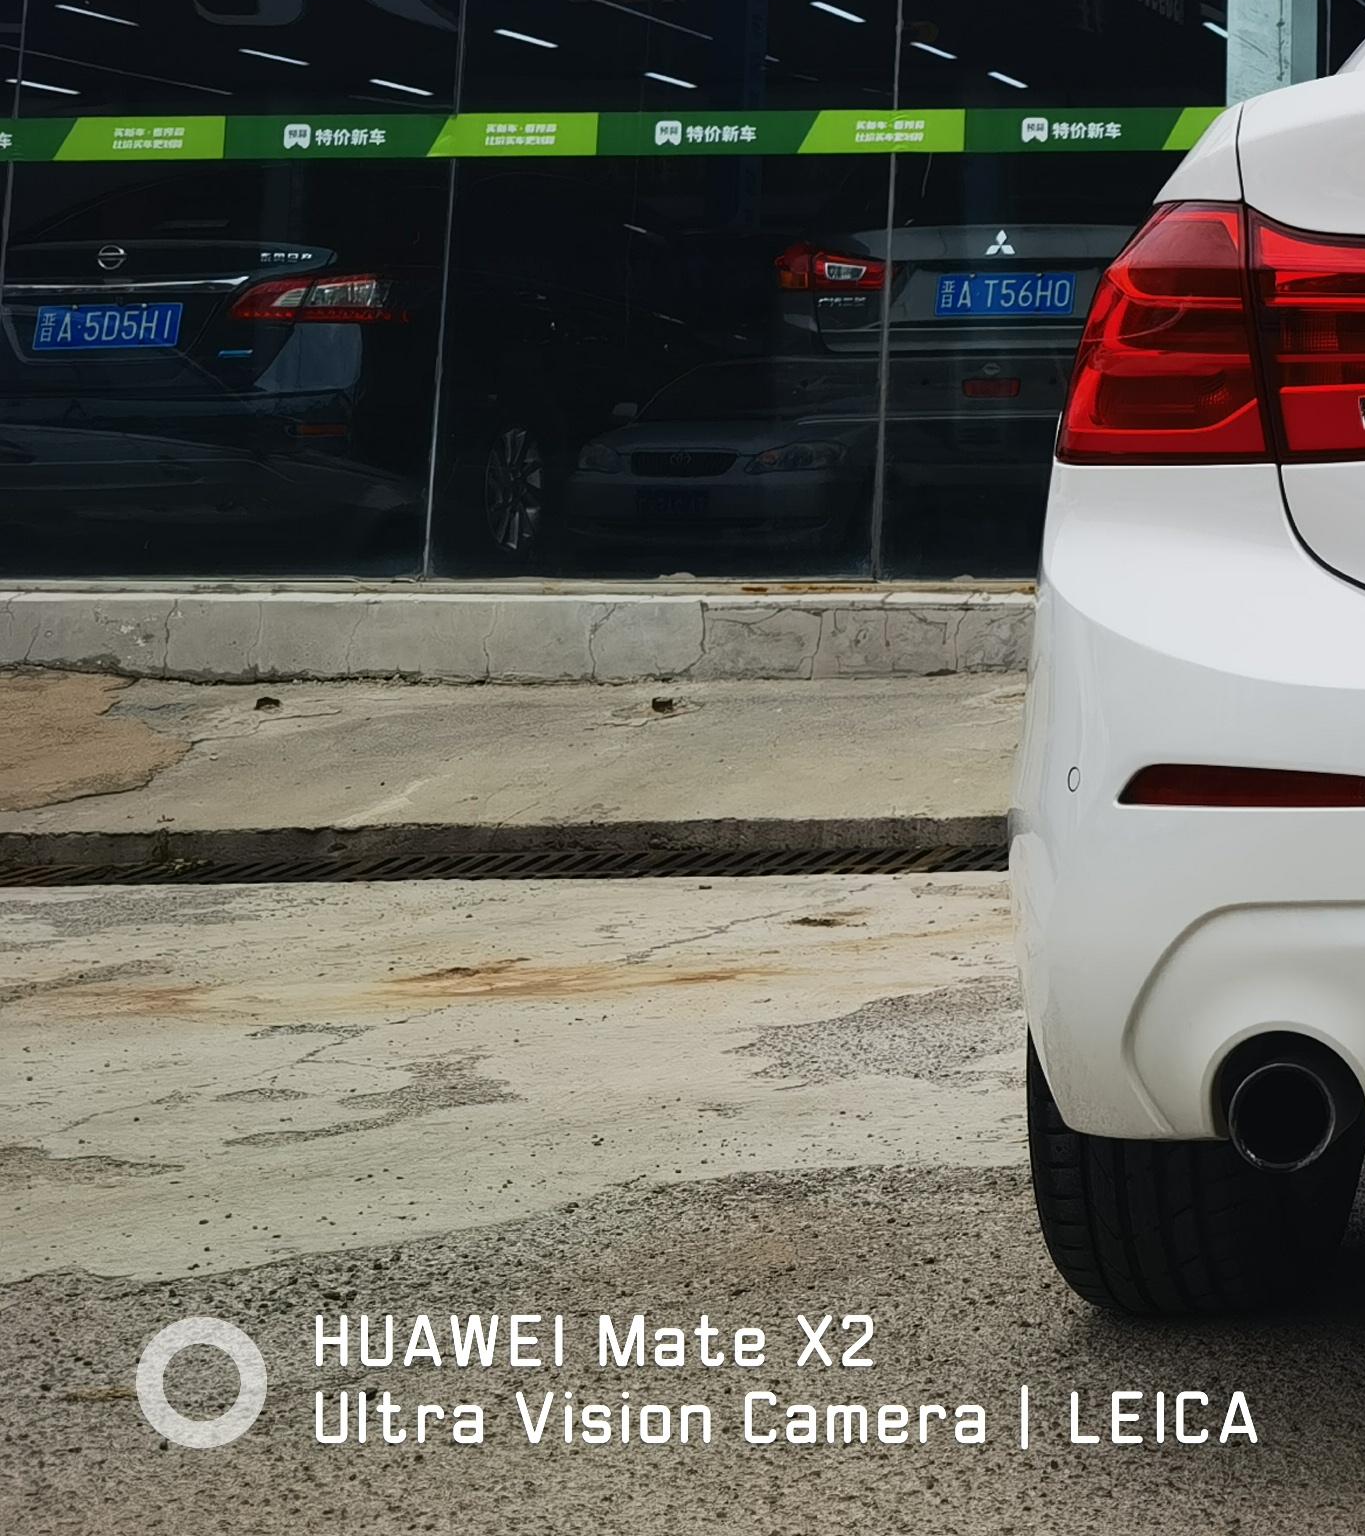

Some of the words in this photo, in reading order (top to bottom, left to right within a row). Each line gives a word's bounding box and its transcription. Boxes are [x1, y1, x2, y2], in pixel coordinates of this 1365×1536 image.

[315, 128, 386, 146] 特价新车
[686, 124, 757, 143] 特价新车
[1052, 121, 1122, 140] 特价新车
